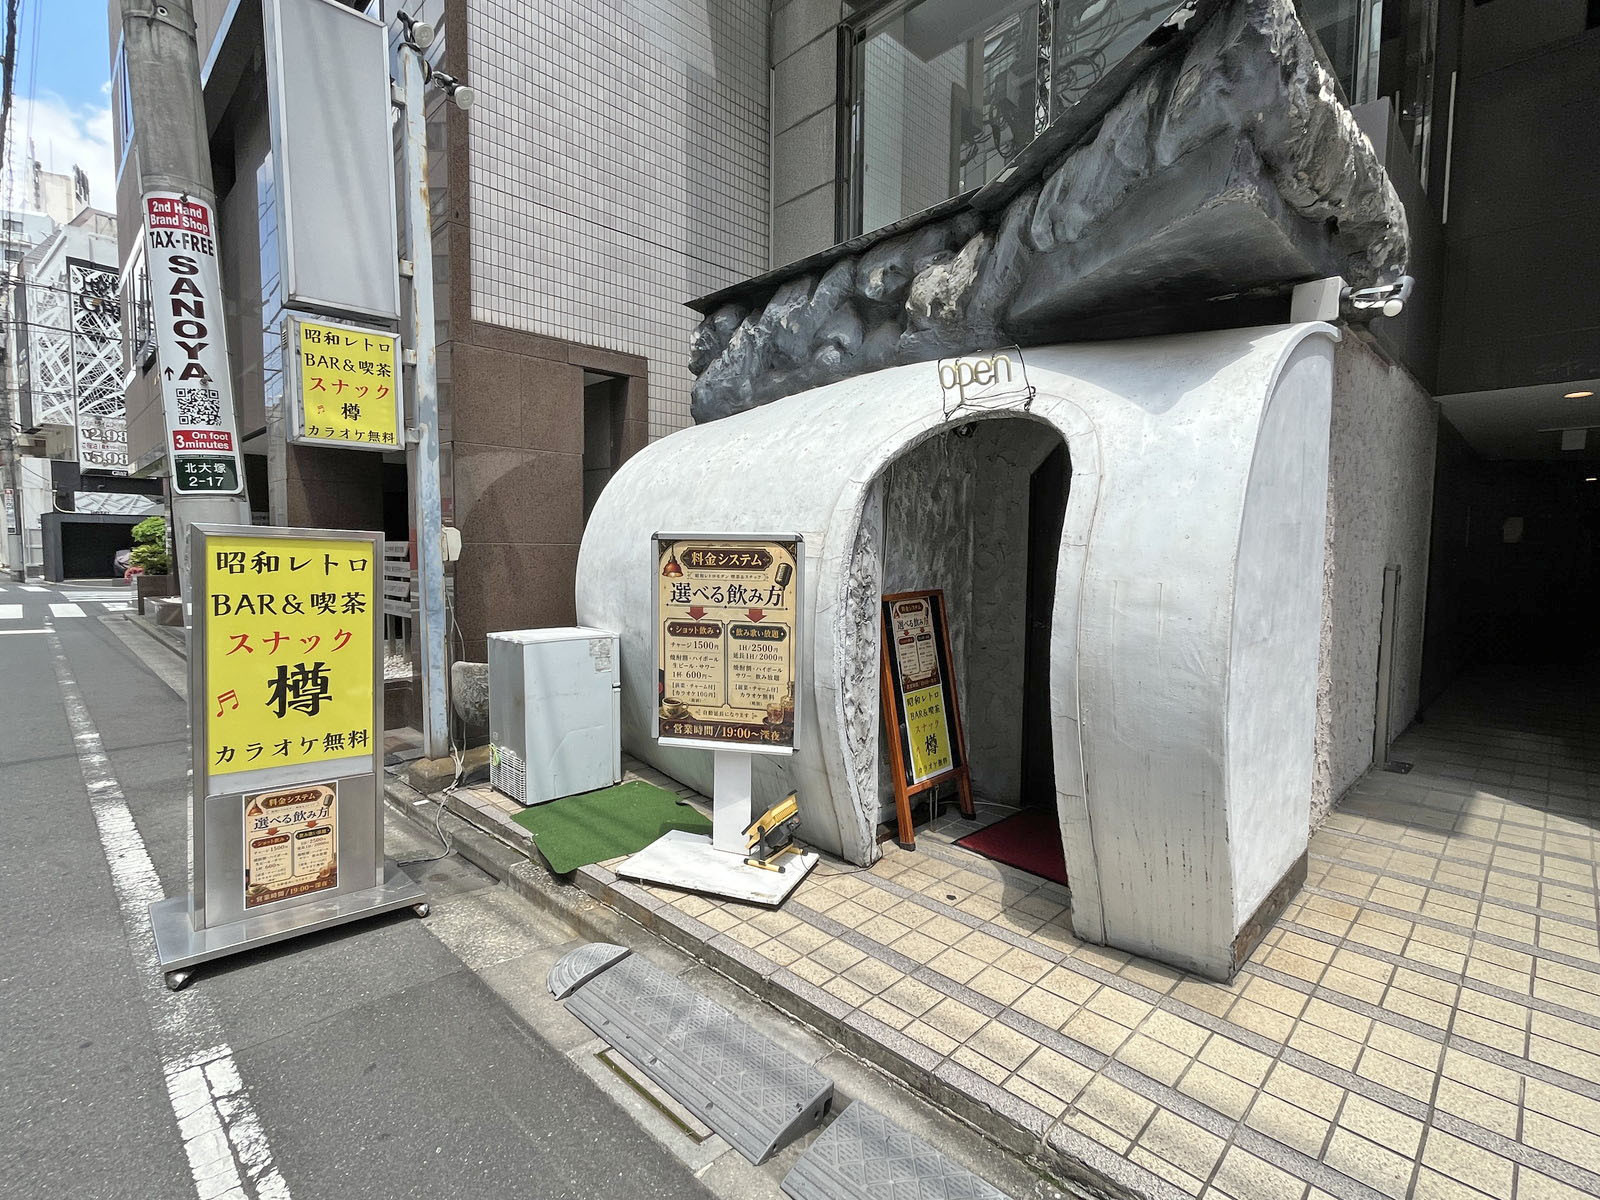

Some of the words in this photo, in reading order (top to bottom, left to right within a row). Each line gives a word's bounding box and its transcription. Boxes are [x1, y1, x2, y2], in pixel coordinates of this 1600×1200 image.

[153, 201, 171, 212] 2nd
[174, 204, 202, 219] Hand
[150, 215, 179, 225] Brand
[182, 218, 208, 234] Shop
[150, 231, 214, 256] TAX-FREE
[168, 255, 214, 383] SANOYA
[305, 329, 390, 352] 昭和レトロ
[305, 353, 391, 377] BAR&喫茶
[309, 377, 389, 400] スナック
[940, 355, 1012, 403] open
[341, 403, 361, 421] 樽
[210, 432, 228, 440] foot
[308, 425, 394, 443] カラオケ無料
[185, 463, 226, 473] 北大塚
[189, 477, 224, 486] 2-17
[216, 551, 368, 576] 昭和レトロ
[691, 551, 762, 566] 料金システム
[212, 592, 367, 616] BAR&喫茶
[670, 582, 782, 607] 選べる飲み方
[676, 625, 714, 634] ショット飲み
[226, 629, 353, 656] スナック
[265, 663, 333, 719] 樽
[907, 692, 939, 707] 昭和レトロ
[910, 705, 940, 720] BAR&喫茶
[915, 720, 939, 733] スナック
[214, 730, 370, 766] カラオケ無料
[925, 734, 938, 756] 樽
[254, 807, 328, 830] 選べる飲み方
